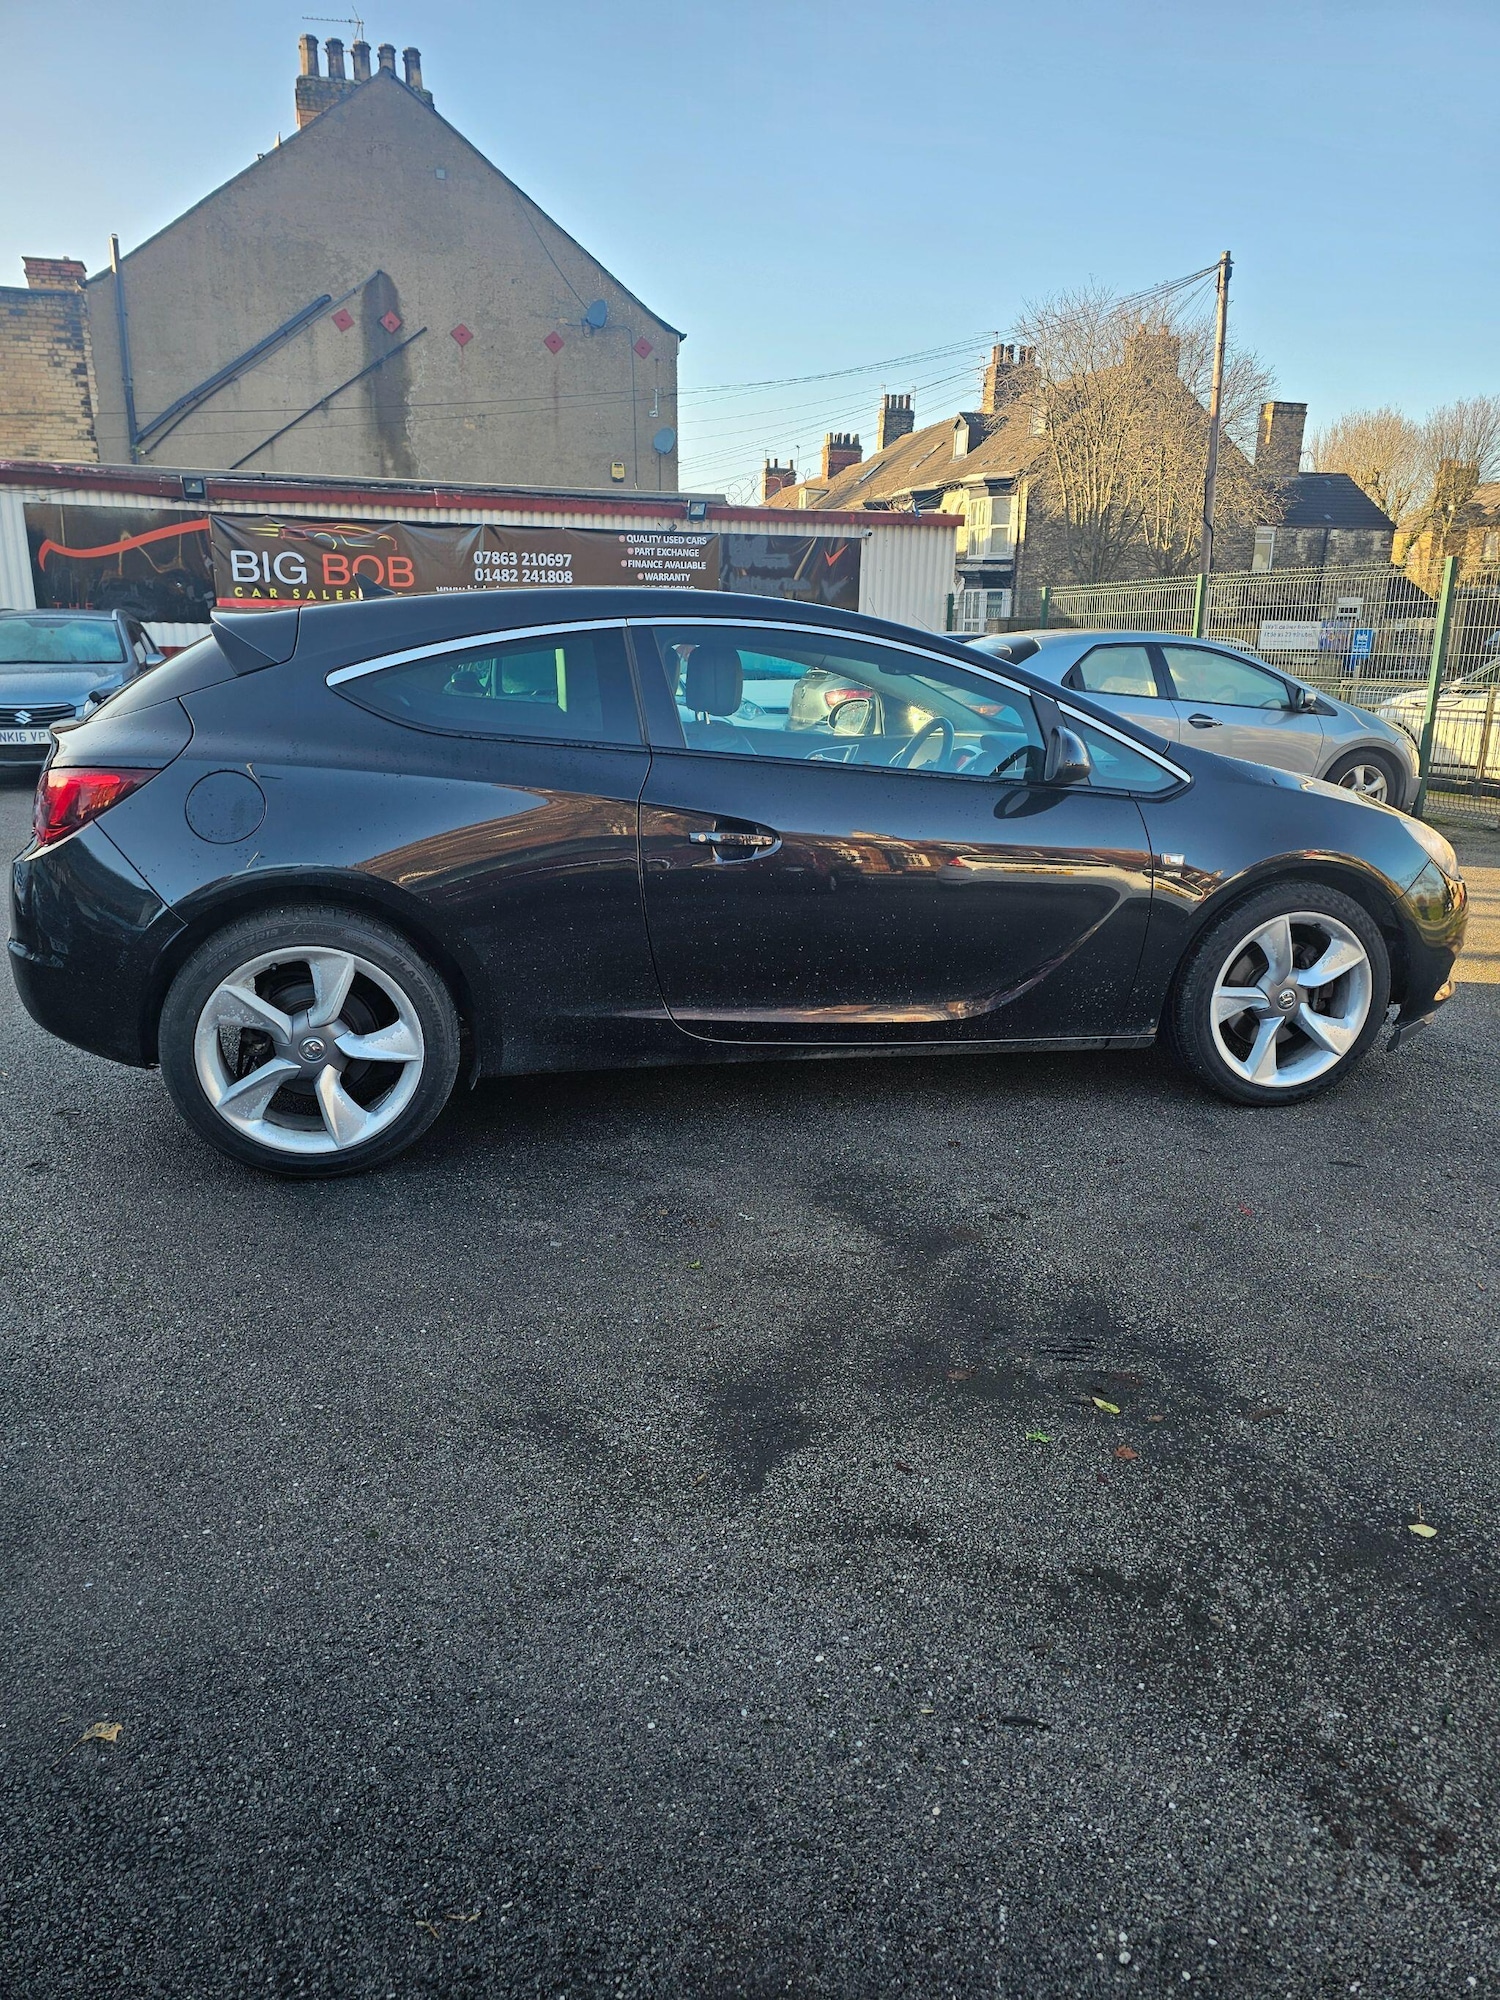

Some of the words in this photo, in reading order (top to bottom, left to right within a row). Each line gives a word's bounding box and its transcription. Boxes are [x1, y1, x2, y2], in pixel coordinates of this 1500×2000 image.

[626, 534, 661, 544] QUALITY
[663, 536, 685, 544] USED
[686, 537, 707, 545] CARS
[634, 547, 656, 556] PART
[656, 548, 700, 557] EXCHANGE
[473, 551, 517, 565] 07863
[521, 552, 572, 567] 210697
[230, 550, 308, 585] BIG
[322, 553, 415, 587] BOB
[627, 560, 663, 569] FINANCE
[664, 561, 707, 570] AVALIABLE
[474, 568, 519, 582] 01482
[522, 569, 573, 584] 241808
[644, 572, 691, 582] WARRANTY
[234, 586, 279, 599] CAR
[292, 588, 358, 600] SALES
[0, 731, 27, 742] NK16
